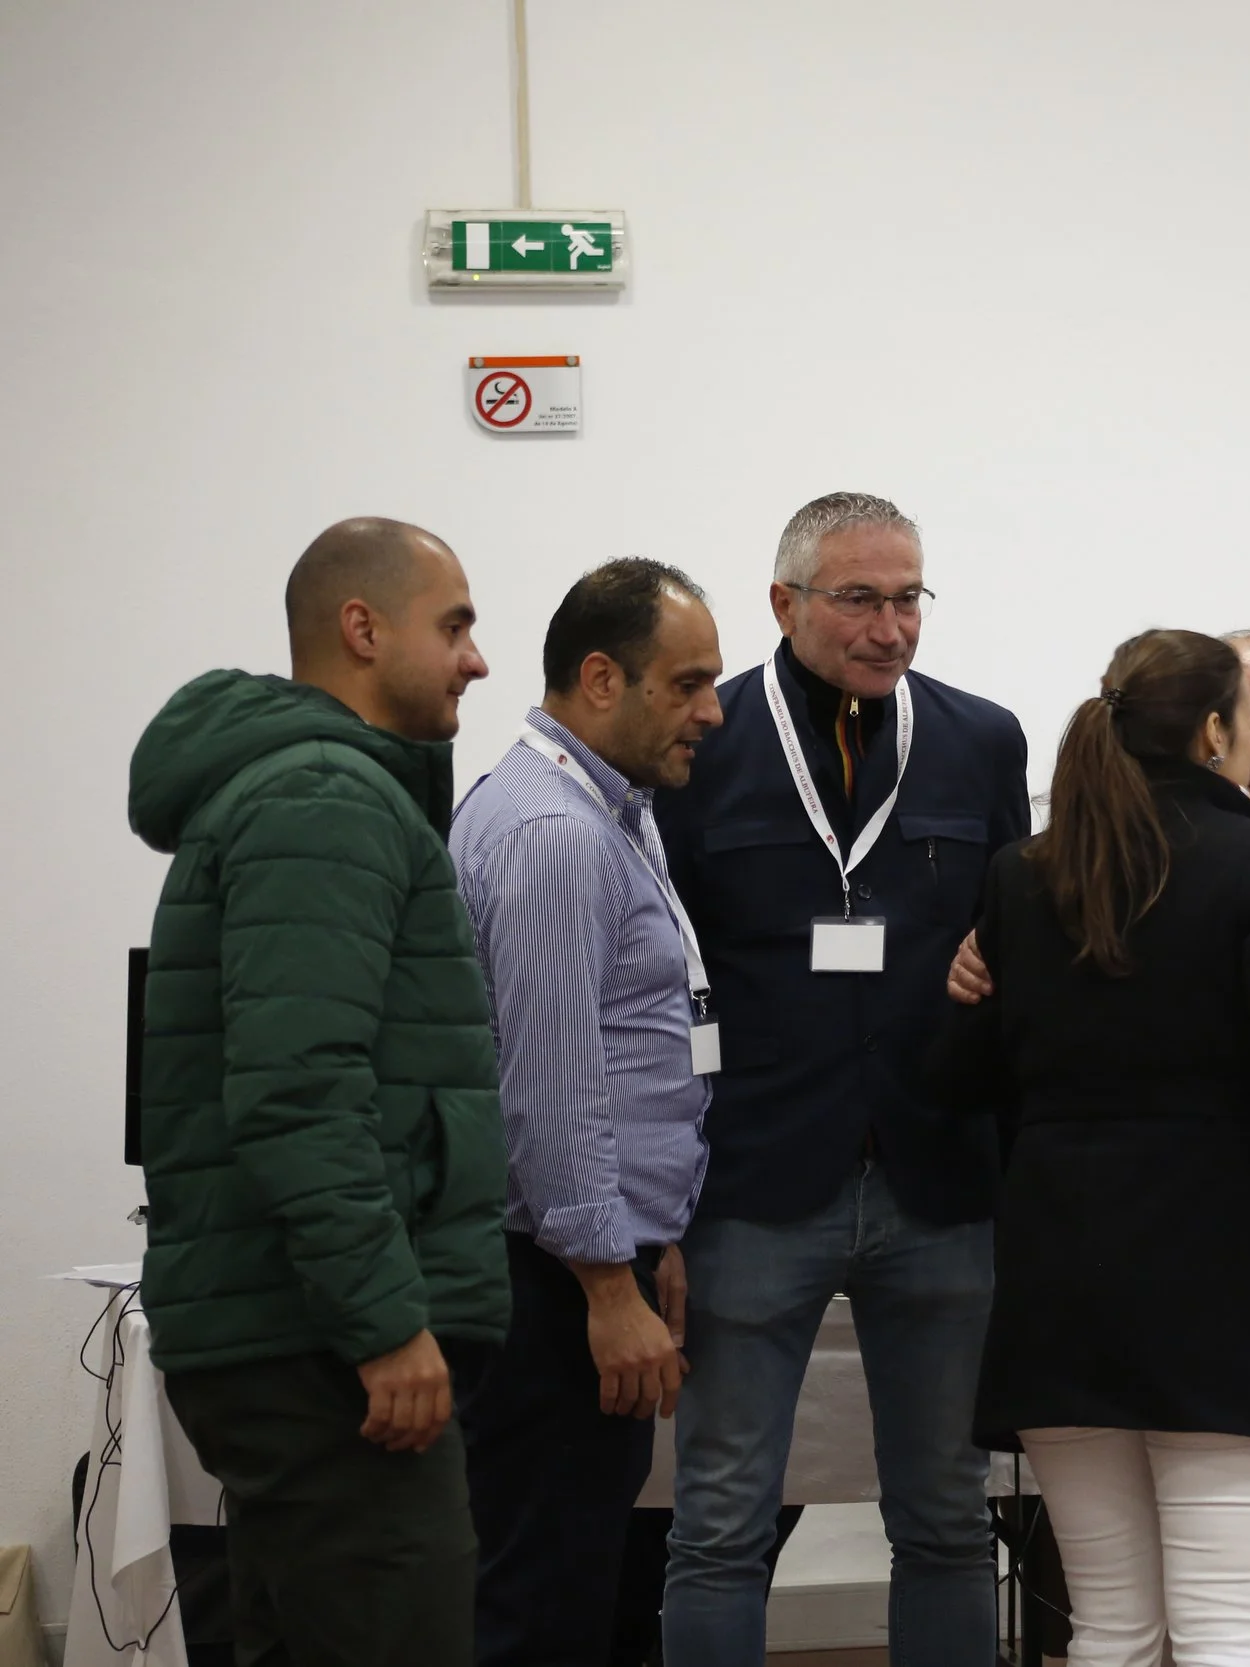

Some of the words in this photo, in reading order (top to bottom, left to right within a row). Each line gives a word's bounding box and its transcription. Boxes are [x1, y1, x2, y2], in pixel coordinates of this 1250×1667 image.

[769, 683, 785, 720] CONFRARIA
[780, 720, 789, 731] DO
[902, 722, 909, 733] DE
[784, 731, 799, 763] BACCHUS
[794, 763, 803, 774] DE
[799, 775, 819, 814] ALBUFEIRA
